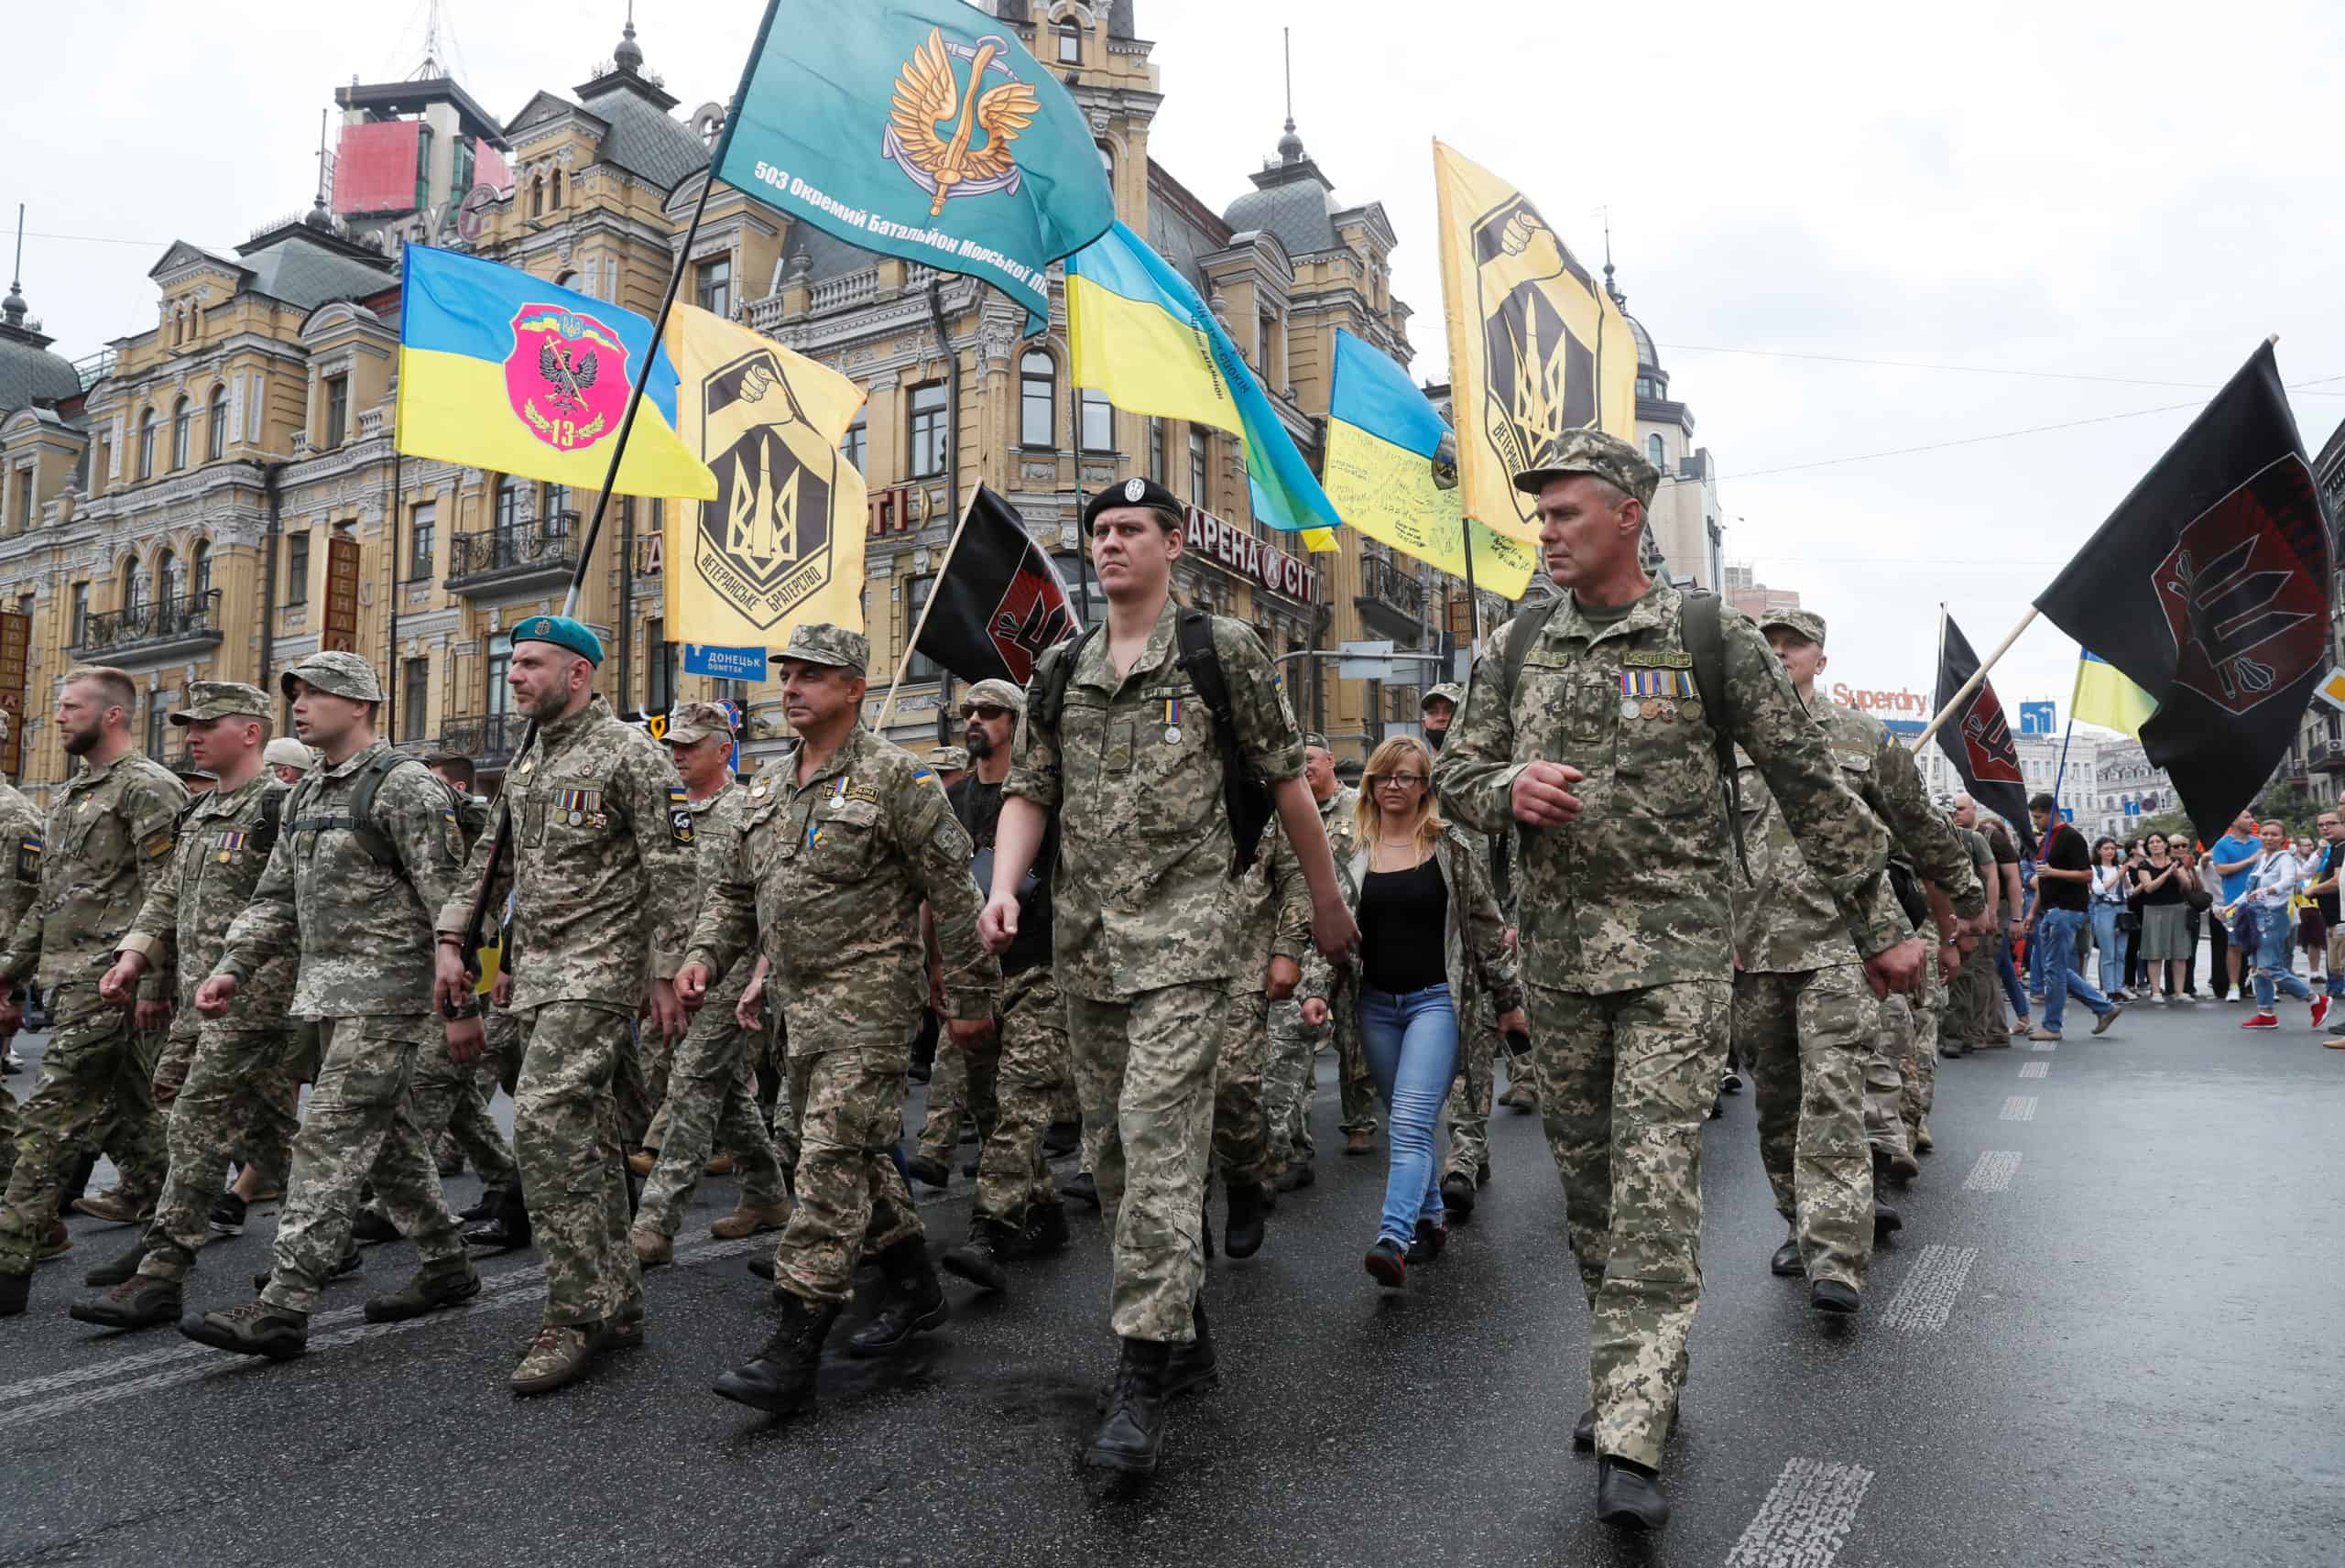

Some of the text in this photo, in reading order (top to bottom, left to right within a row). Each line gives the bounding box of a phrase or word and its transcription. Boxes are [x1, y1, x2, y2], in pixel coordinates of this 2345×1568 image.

[754, 160, 789, 190] 503
[791, 178, 867, 229] Окремий
[959, 238, 1032, 284] Морської
[551, 418, 574, 447] 13
[1187, 508, 1260, 579] АРЕНА
[335, 545, 352, 629] АРЕНА
[701, 553, 761, 612] ВЕТЕРАНСЬКЕ
[765, 565, 823, 613] БРАТЕРСТВО
[708, 652, 761, 668] ДОНЕЦЬК
[708, 663, 744, 674] DONETSK
[1833, 682, 1927, 717] Superdry
